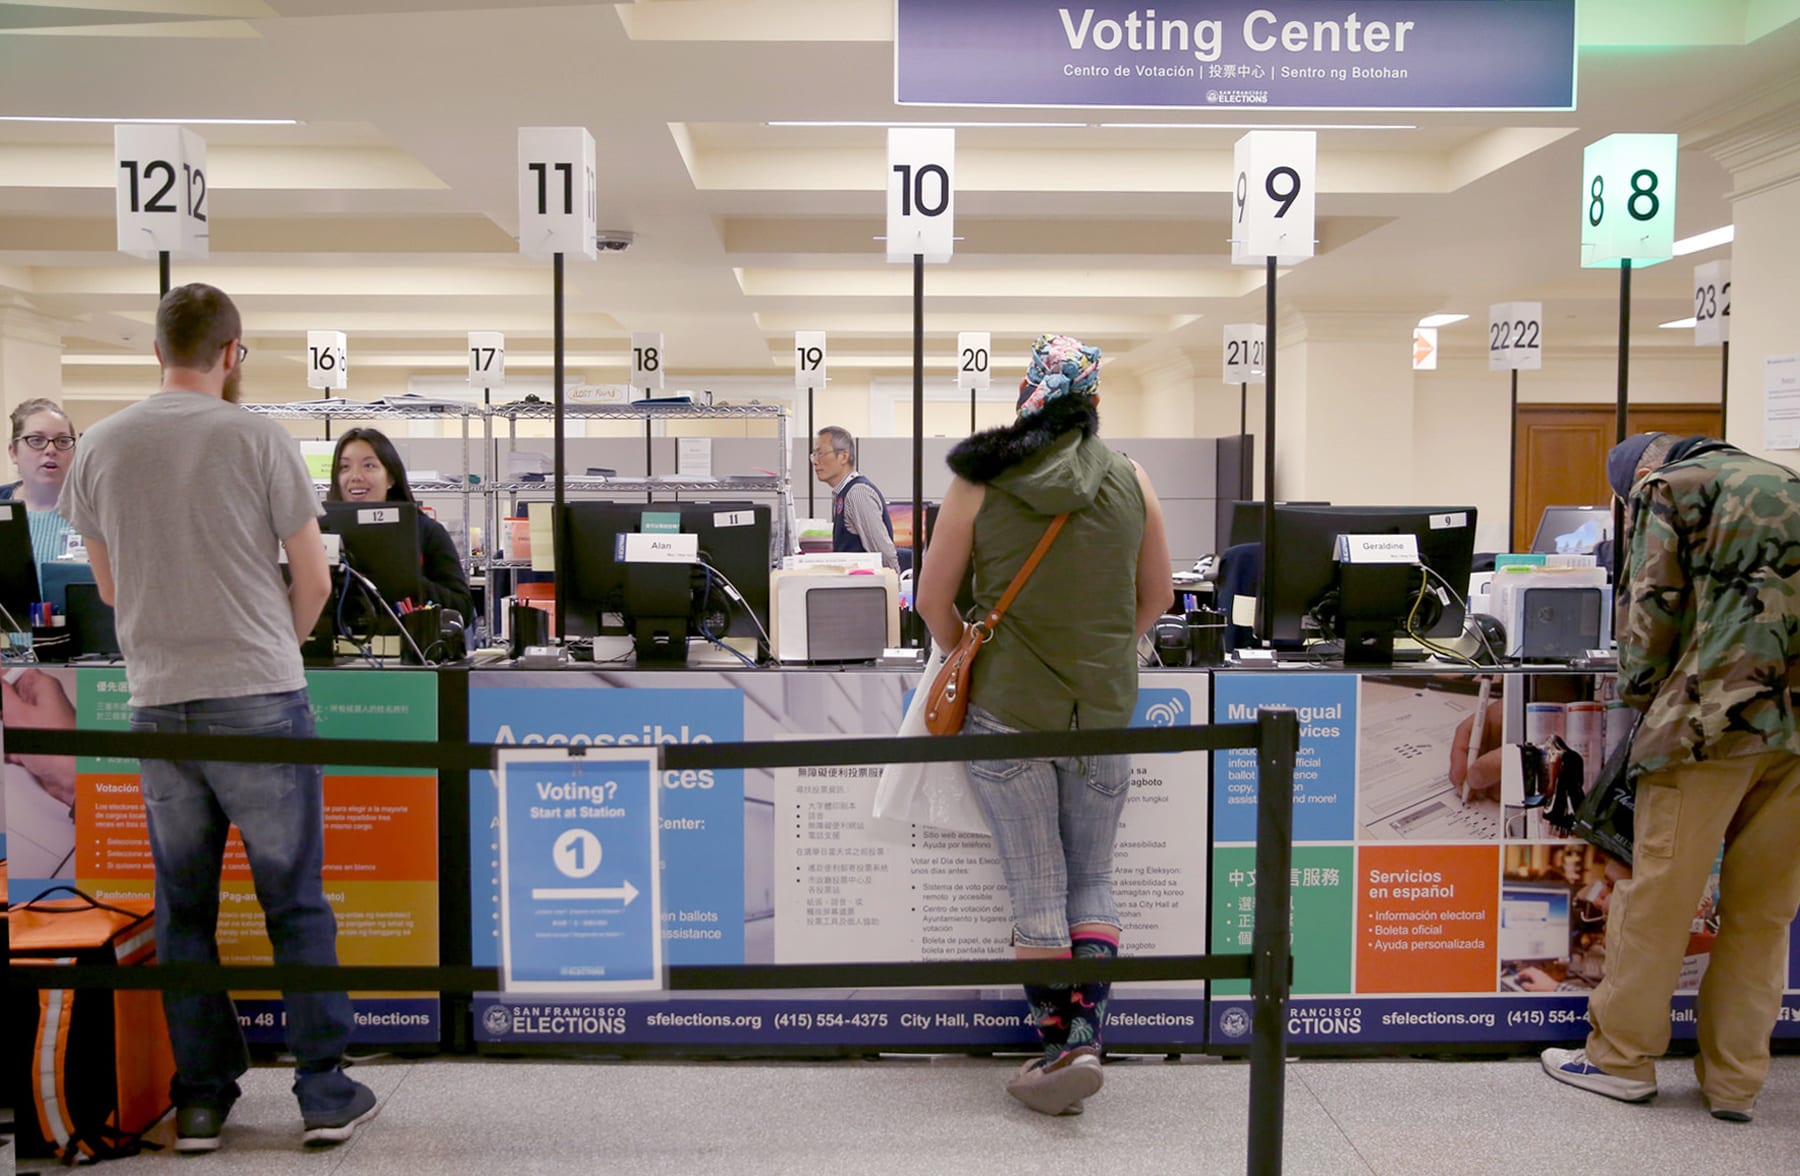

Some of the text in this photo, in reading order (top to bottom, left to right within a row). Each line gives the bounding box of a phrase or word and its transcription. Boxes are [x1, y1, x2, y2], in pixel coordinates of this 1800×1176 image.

[1058, 9, 1415, 62] Voting Center
[1063, 64, 1194, 78] Centro de Votación
[1208, 64, 1265, 79] 投票中心
[1281, 66, 1408, 81] Sentro ng Botohan
[1218, 95, 1268, 103] ELECTIONS
[120, 160, 177, 213] 12
[183, 162, 207, 223] 12
[528, 162, 573, 215] 11
[892, 163, 949, 217] 10
[1265, 166, 1301, 219] 9
[1236, 171, 1247, 224] 9
[1589, 175, 1604, 227] 8
[1627, 168, 1660, 221] 8
[1696, 284, 1717, 322] 23
[1490, 321, 1510, 351] 22
[1514, 320, 1539, 348] 22
[310, 347, 335, 370] 16
[471, 347, 496, 371] 17
[633, 347, 659, 371] 18
[797, 347, 823, 371] 19
[962, 348, 988, 372] 20
[1227, 340, 1248, 365] 21
[1253, 340, 1264, 366] 21
[372, 511, 384, 522] 12
[729, 514, 739, 524] 11
[1445, 516, 1452, 526] 9
[1362, 542, 1404, 550] Geraldine
[1299, 724, 1340, 737] vices
[1296, 758, 1321, 767] fficial
[1130, 778, 1162, 788] agboto
[1228, 771, 1255, 780] ballot
[95, 783, 139, 793] Votación
[536, 781, 618, 804] Voting?
[1228, 794, 1337, 804] assist nd more!
[530, 806, 625, 819] Start at Station
[564, 836, 585, 870] 1
[1229, 868, 1340, 888] 中文言服務
[1369, 869, 1442, 883] Servicios
[219, 891, 258, 903] (Pag-an
[1369, 884, 1454, 901] en español
[1139, 901, 1153, 909] City
[680, 911, 718, 922] ballots
[1375, 910, 1485, 920] Información electoral
[1375, 925, 1443, 935] Boleta oficial
[1374, 939, 1485, 951] Ayuda personalizada
[255, 1013, 274, 1026] 48
[353, 1012, 430, 1026] felections
[513, 1007, 626, 1017] SAN FRANCISCO
[1290, 1008, 1362, 1017] RANCISCO
[513, 1017, 626, 1034] ELECTIONS
[647, 1012, 762, 1029] sfelections.org
[774, 1013, 813, 1030] (415)
[816, 1013, 888, 1026] 554-4375
[900, 1013, 932, 1029] City
[935, 1013, 969, 1028] Hall,
[973, 1014, 1020, 1026] Room
[1106, 1013, 1194, 1026] /sfelections
[1287, 1018, 1362, 1034] CTIONS
[1382, 1011, 1495, 1027] sfelections.org
[1507, 1010, 1544, 1026] (415)
[1548, 1010, 1590, 1023] 554-4
